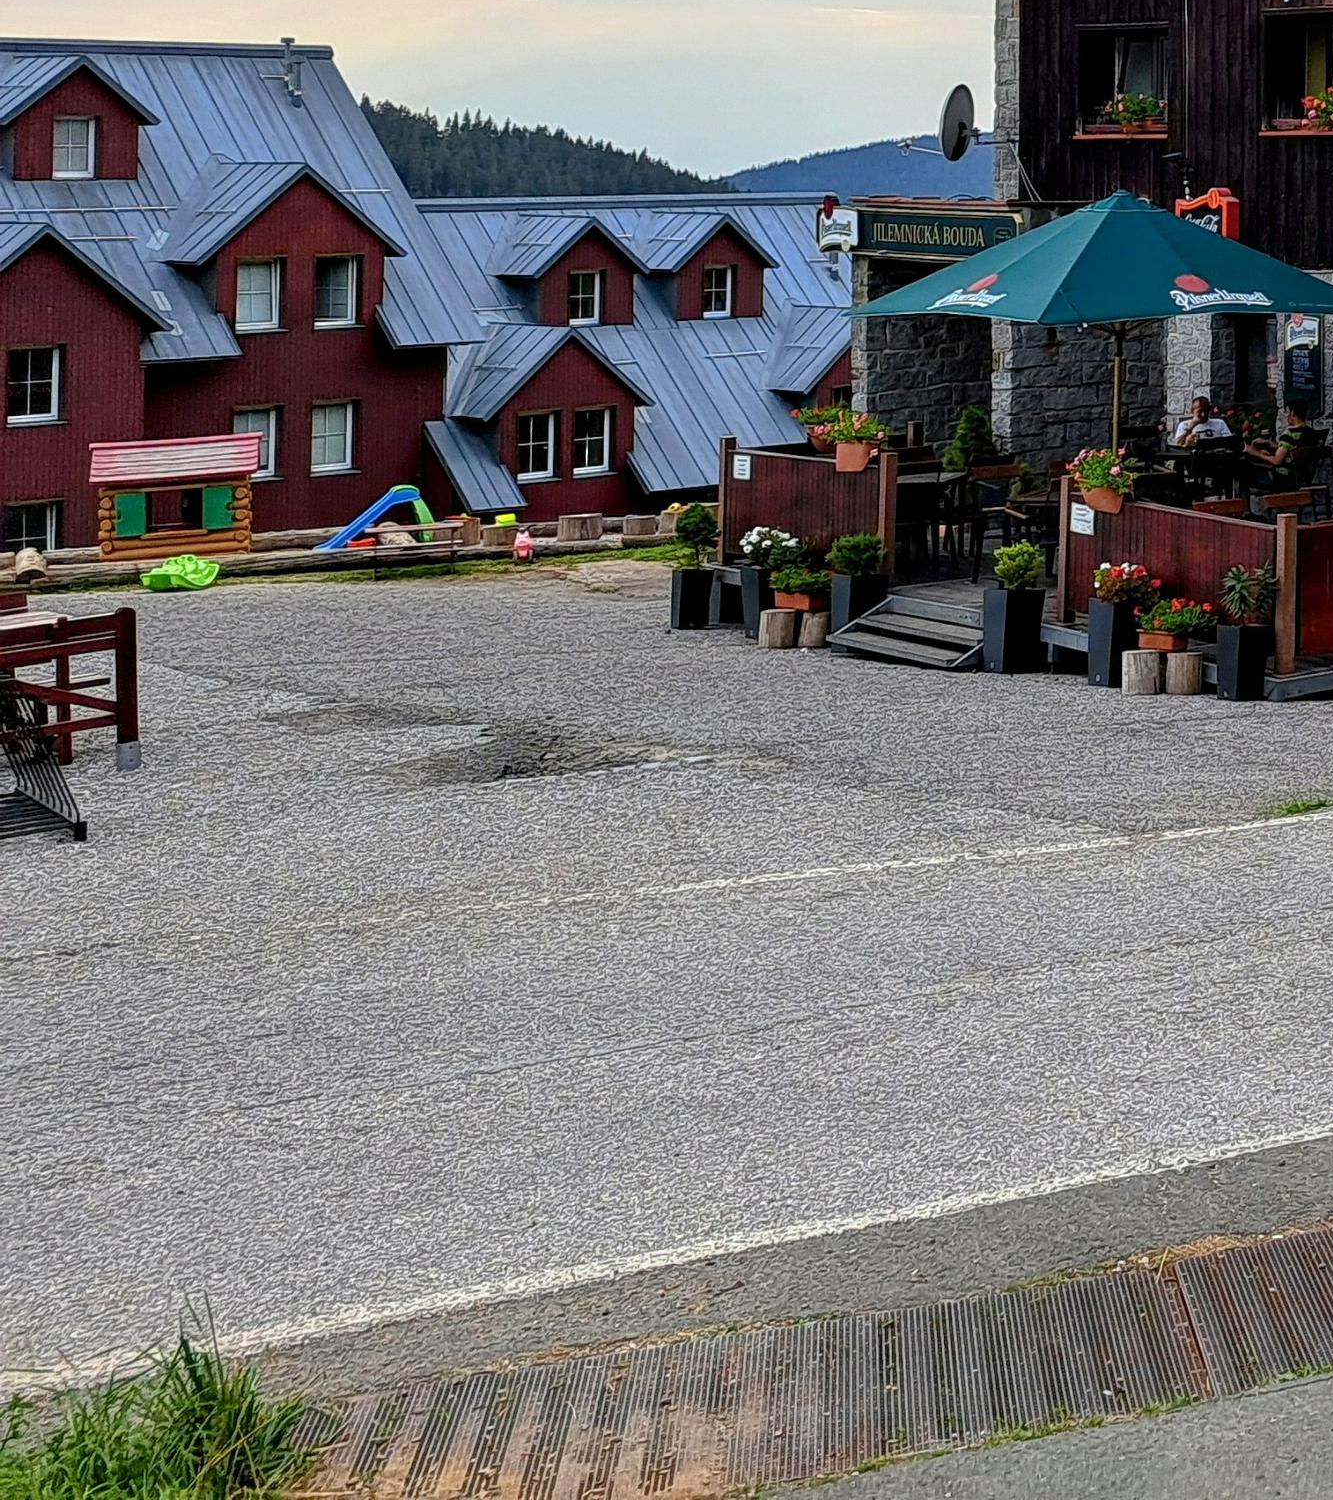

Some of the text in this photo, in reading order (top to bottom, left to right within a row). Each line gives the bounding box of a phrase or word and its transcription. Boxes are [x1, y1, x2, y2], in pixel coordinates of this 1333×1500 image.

[871, 221, 941, 245] JILEMNICKÁ
[942, 225, 986, 247] BOUDA
[1169, 289, 1221, 311] Pilsner
[1213, 287, 1272, 306] Urquell
